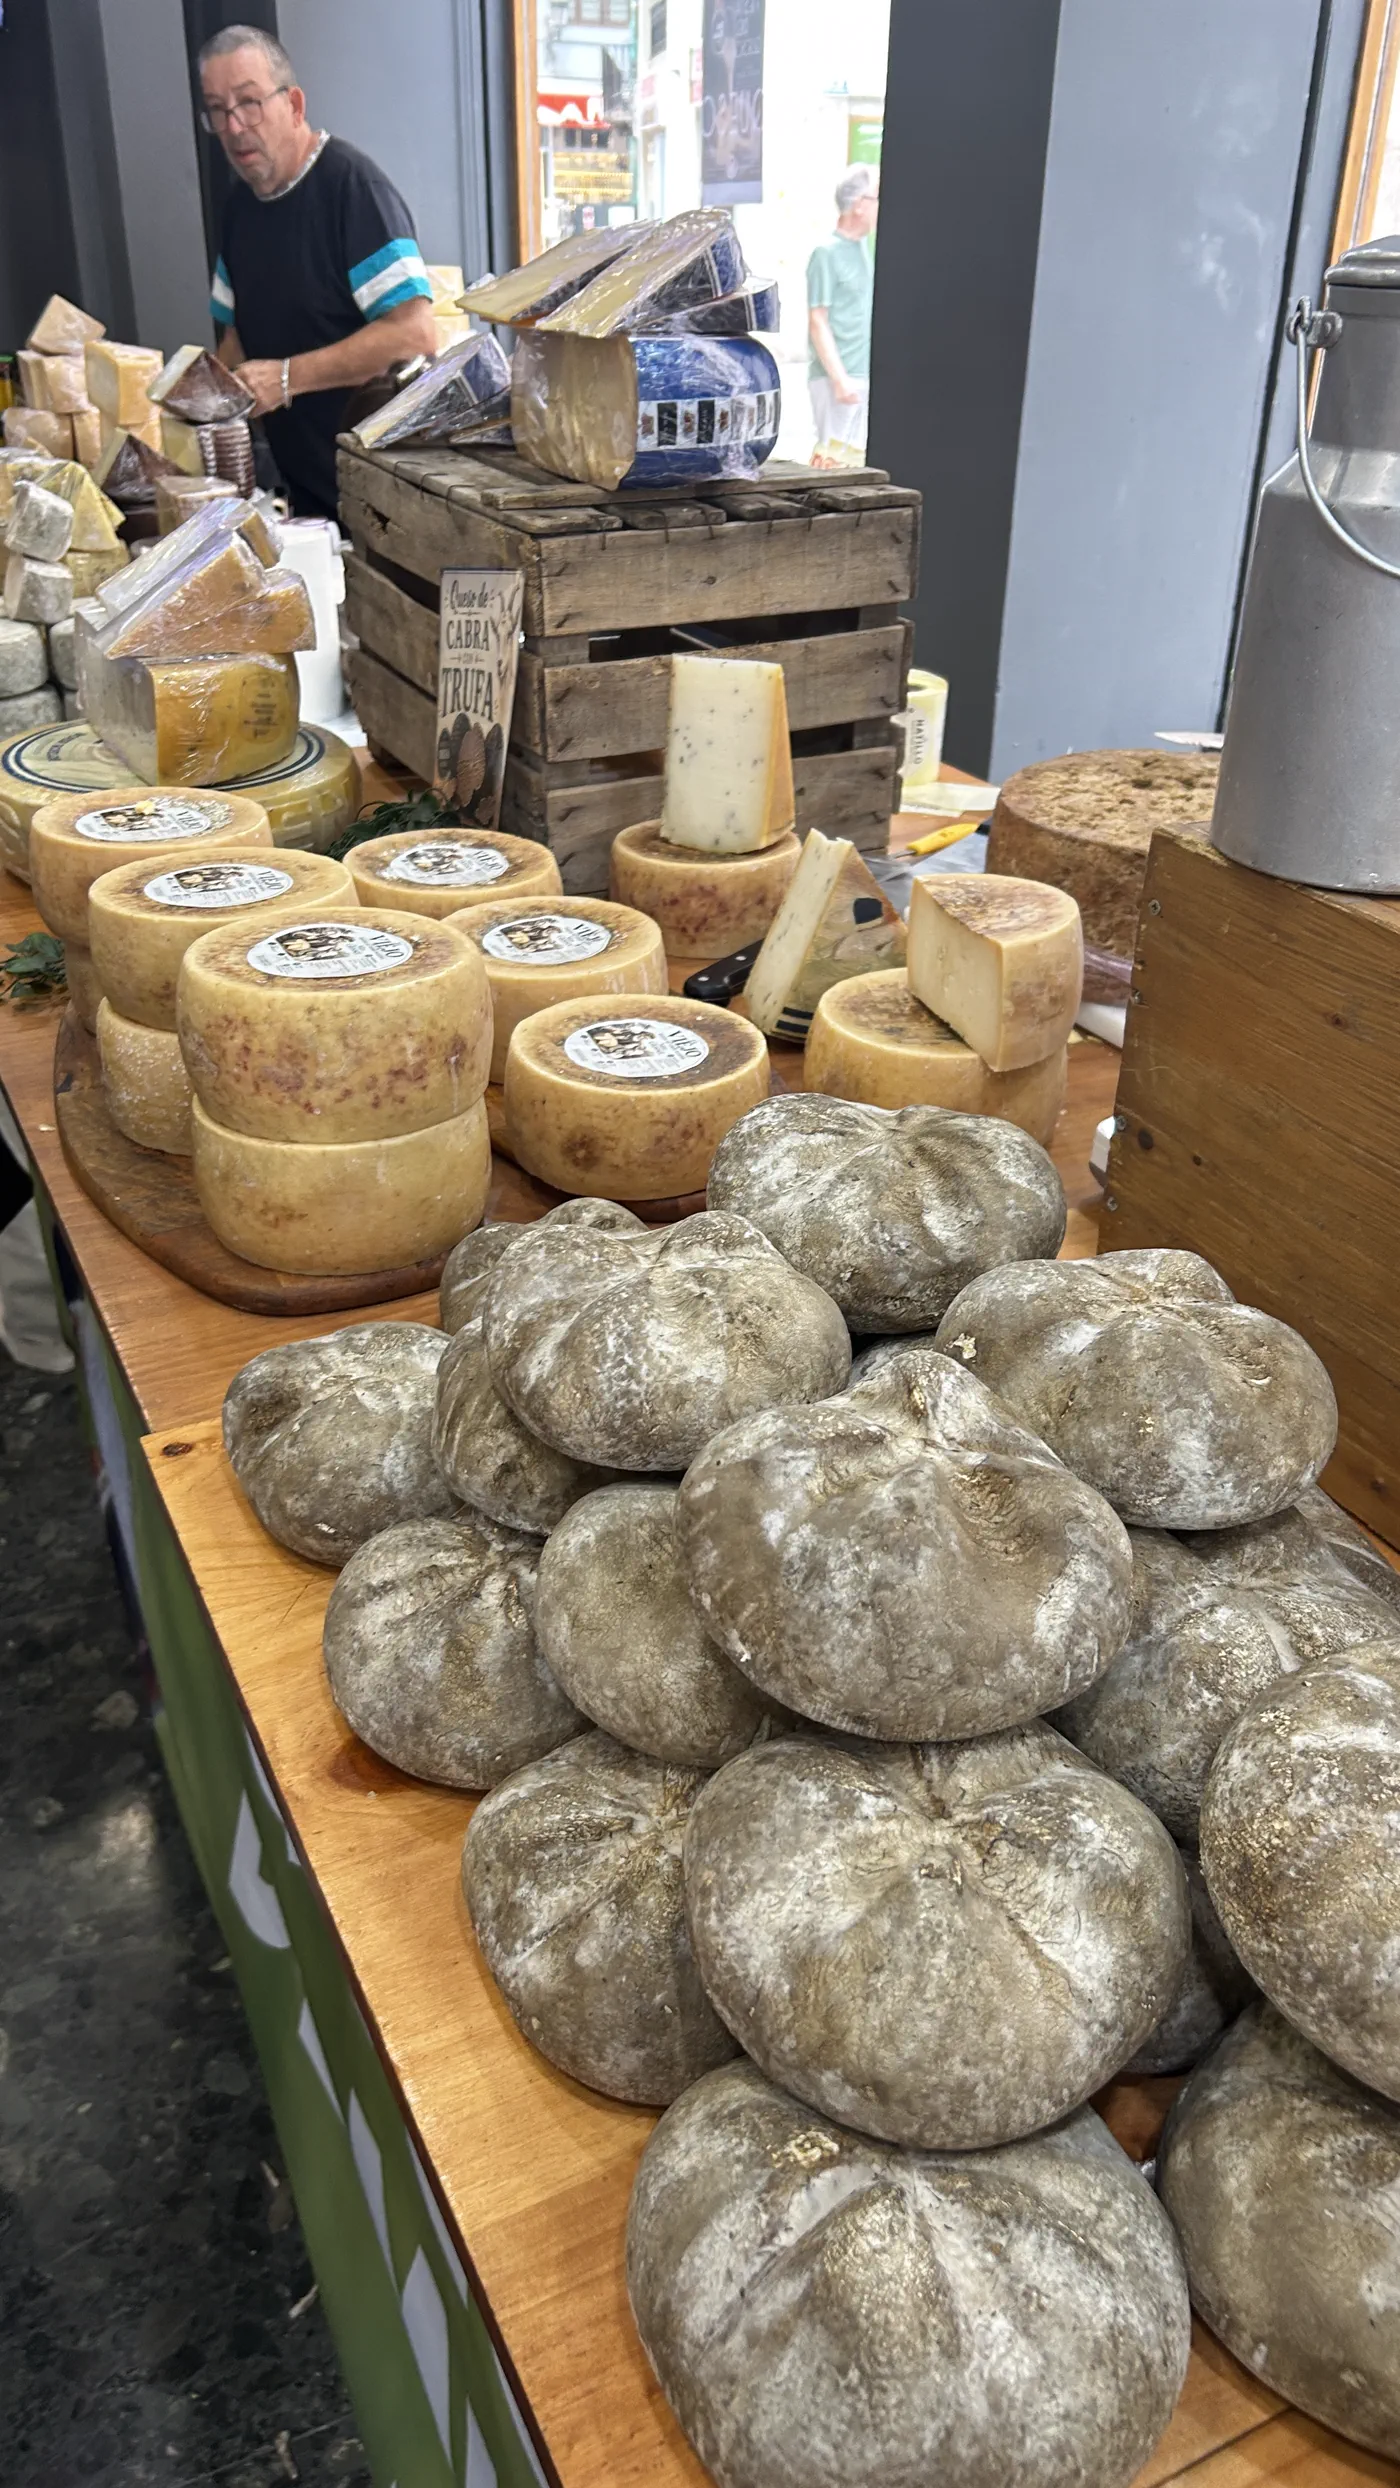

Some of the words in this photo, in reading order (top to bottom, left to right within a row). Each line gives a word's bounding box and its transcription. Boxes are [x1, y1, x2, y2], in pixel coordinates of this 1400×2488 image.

[477, 581, 488, 608] de
[446, 620, 490, 651] CABRA
[442, 667, 493, 723] TRUFA
[369, 934, 405, 958] VIEJO
[667, 1030, 701, 1057] VIEJO
